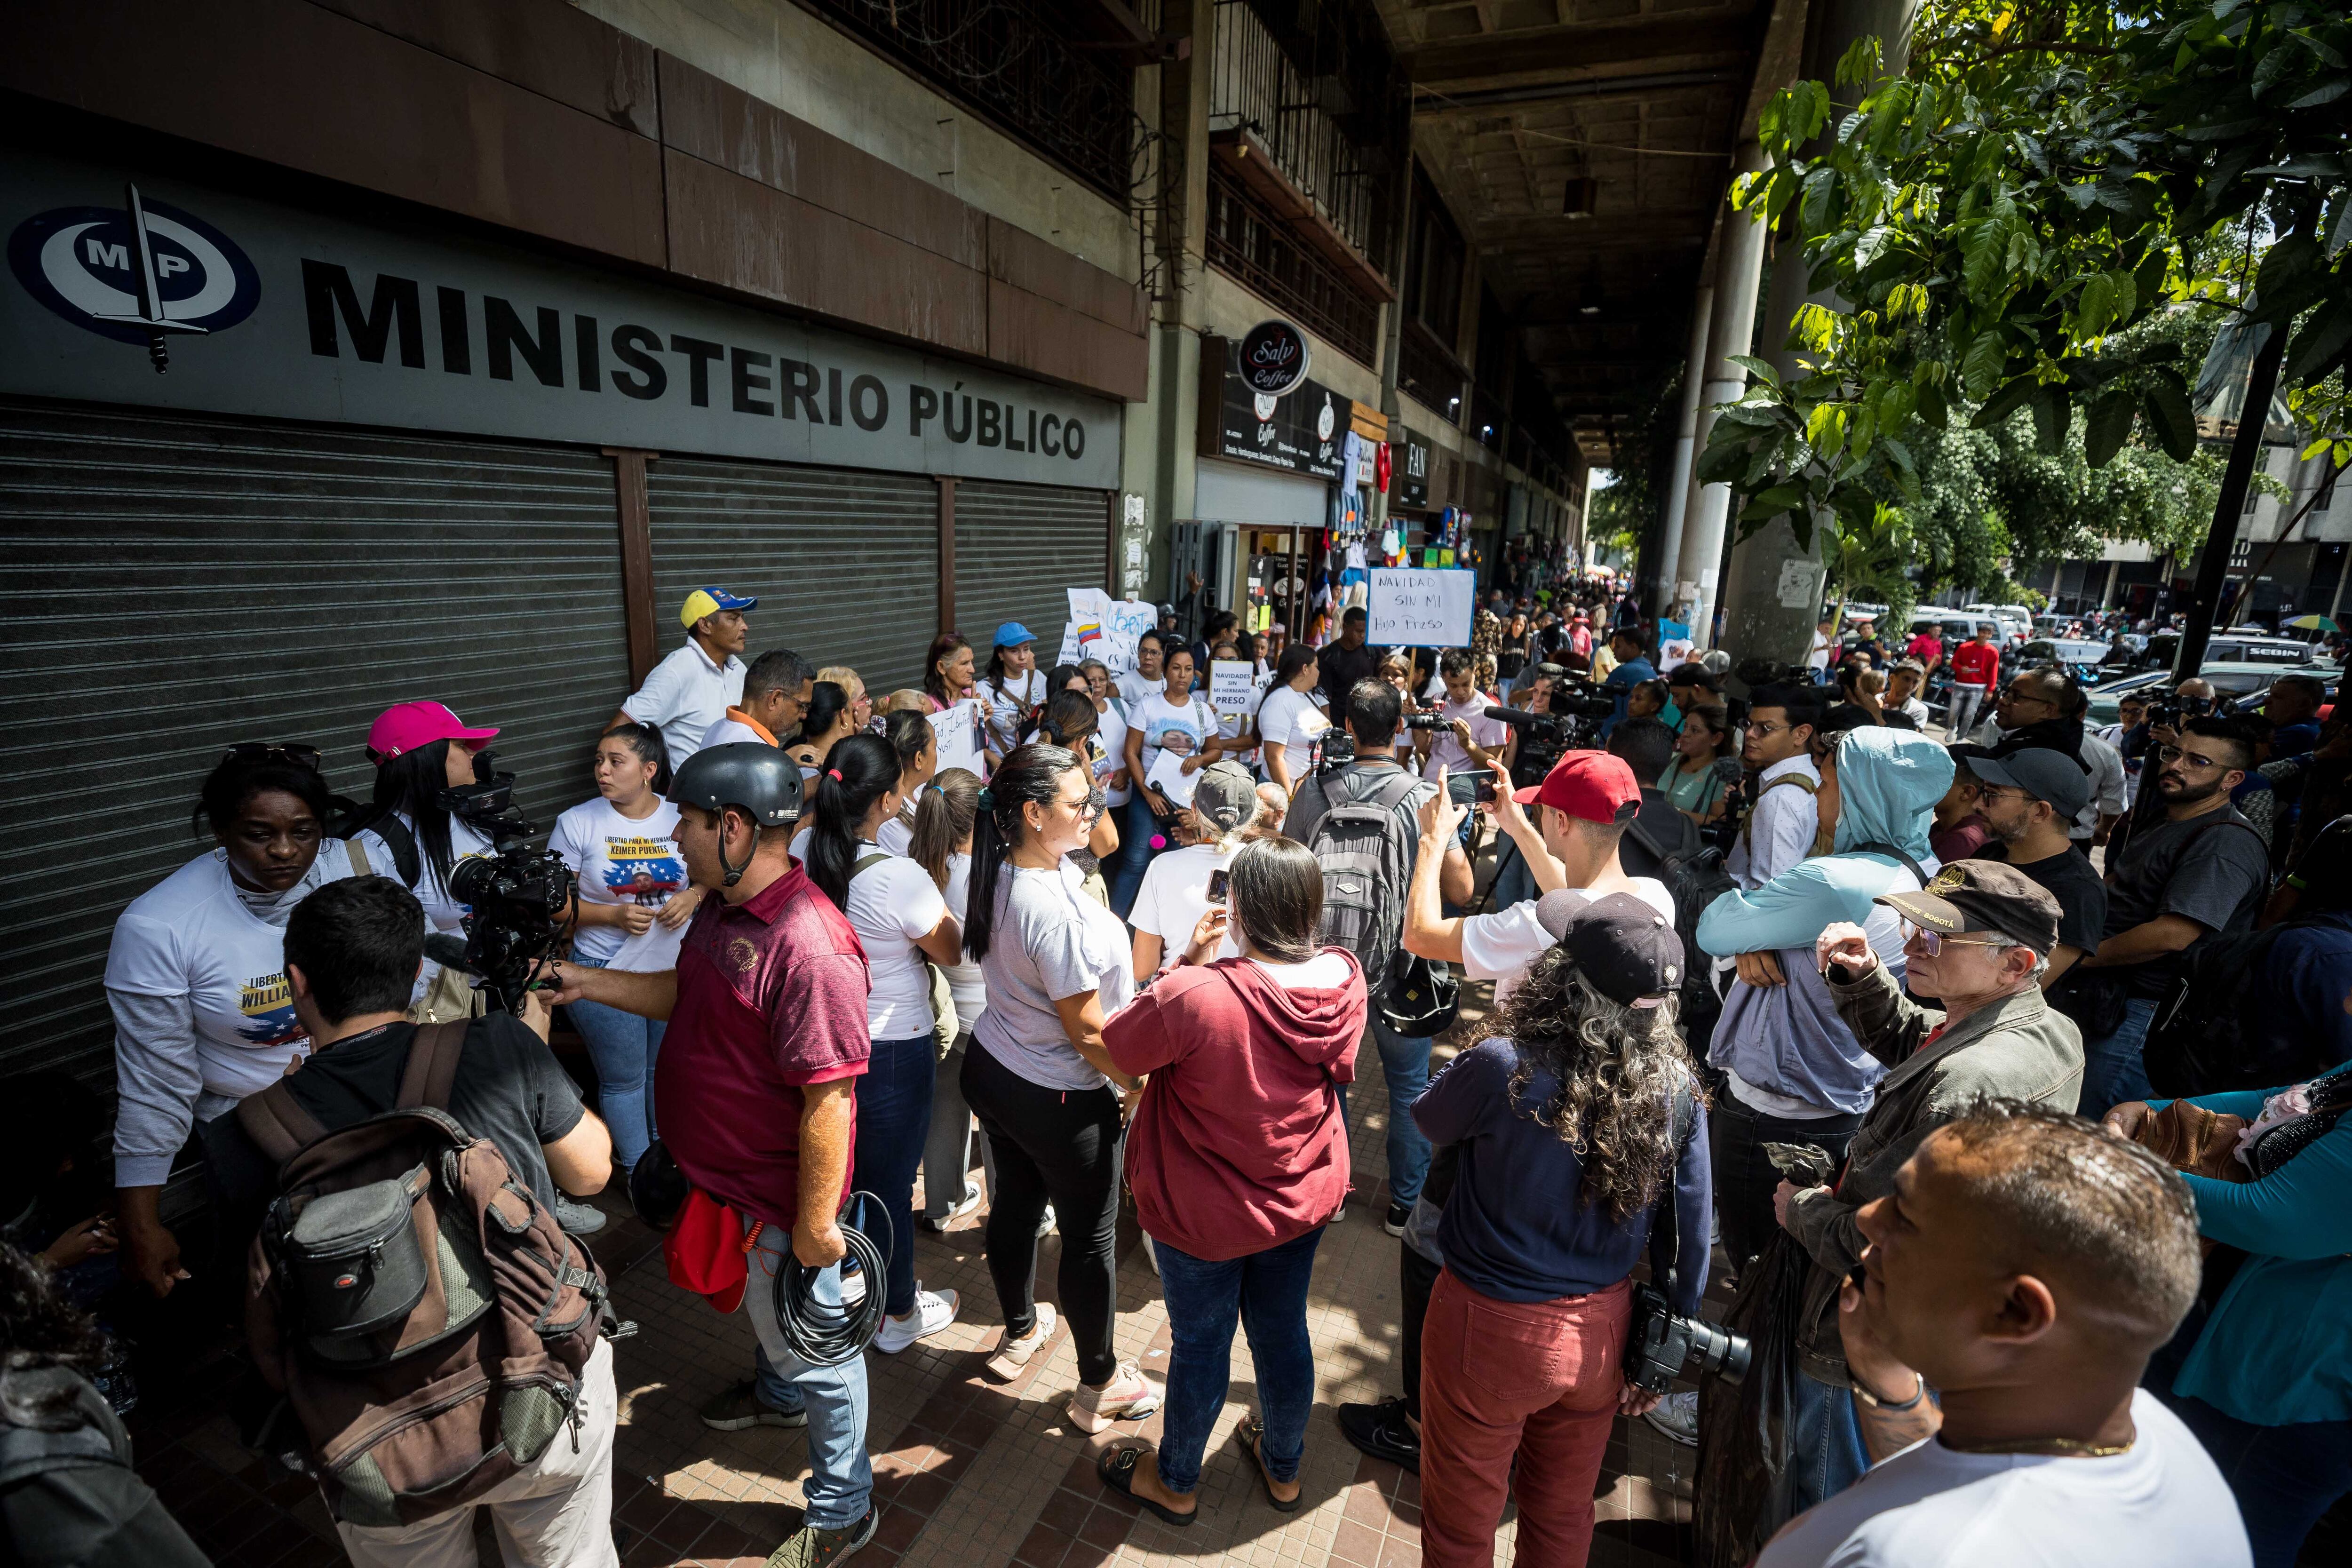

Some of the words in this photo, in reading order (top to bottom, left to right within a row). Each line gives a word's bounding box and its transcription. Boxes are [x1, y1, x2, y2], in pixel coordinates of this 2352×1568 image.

[301, 258, 889, 432] MINISTERIO
[910, 381, 1085, 460] PÚBLICO
[1254, 338, 1294, 365] Saly
[1255, 369, 1293, 388] Coffee
[1258, 423, 1276, 447] Coffee
[1407, 443, 1426, 478] FAN
[1379, 575, 1435, 588] NAVIDAD
[1395, 595, 1417, 606] SIN
[1426, 594, 1441, 608] MI
[2249, 647, 2300, 657] SEBIN
[611, 845, 636, 854] KEIMER
[639, 845, 668, 854] PUENTES
[1923, 912, 1954, 929] BOGOTÁ
[250, 972, 287, 989] LIBERT
[242, 985, 292, 1008] WILLIA
